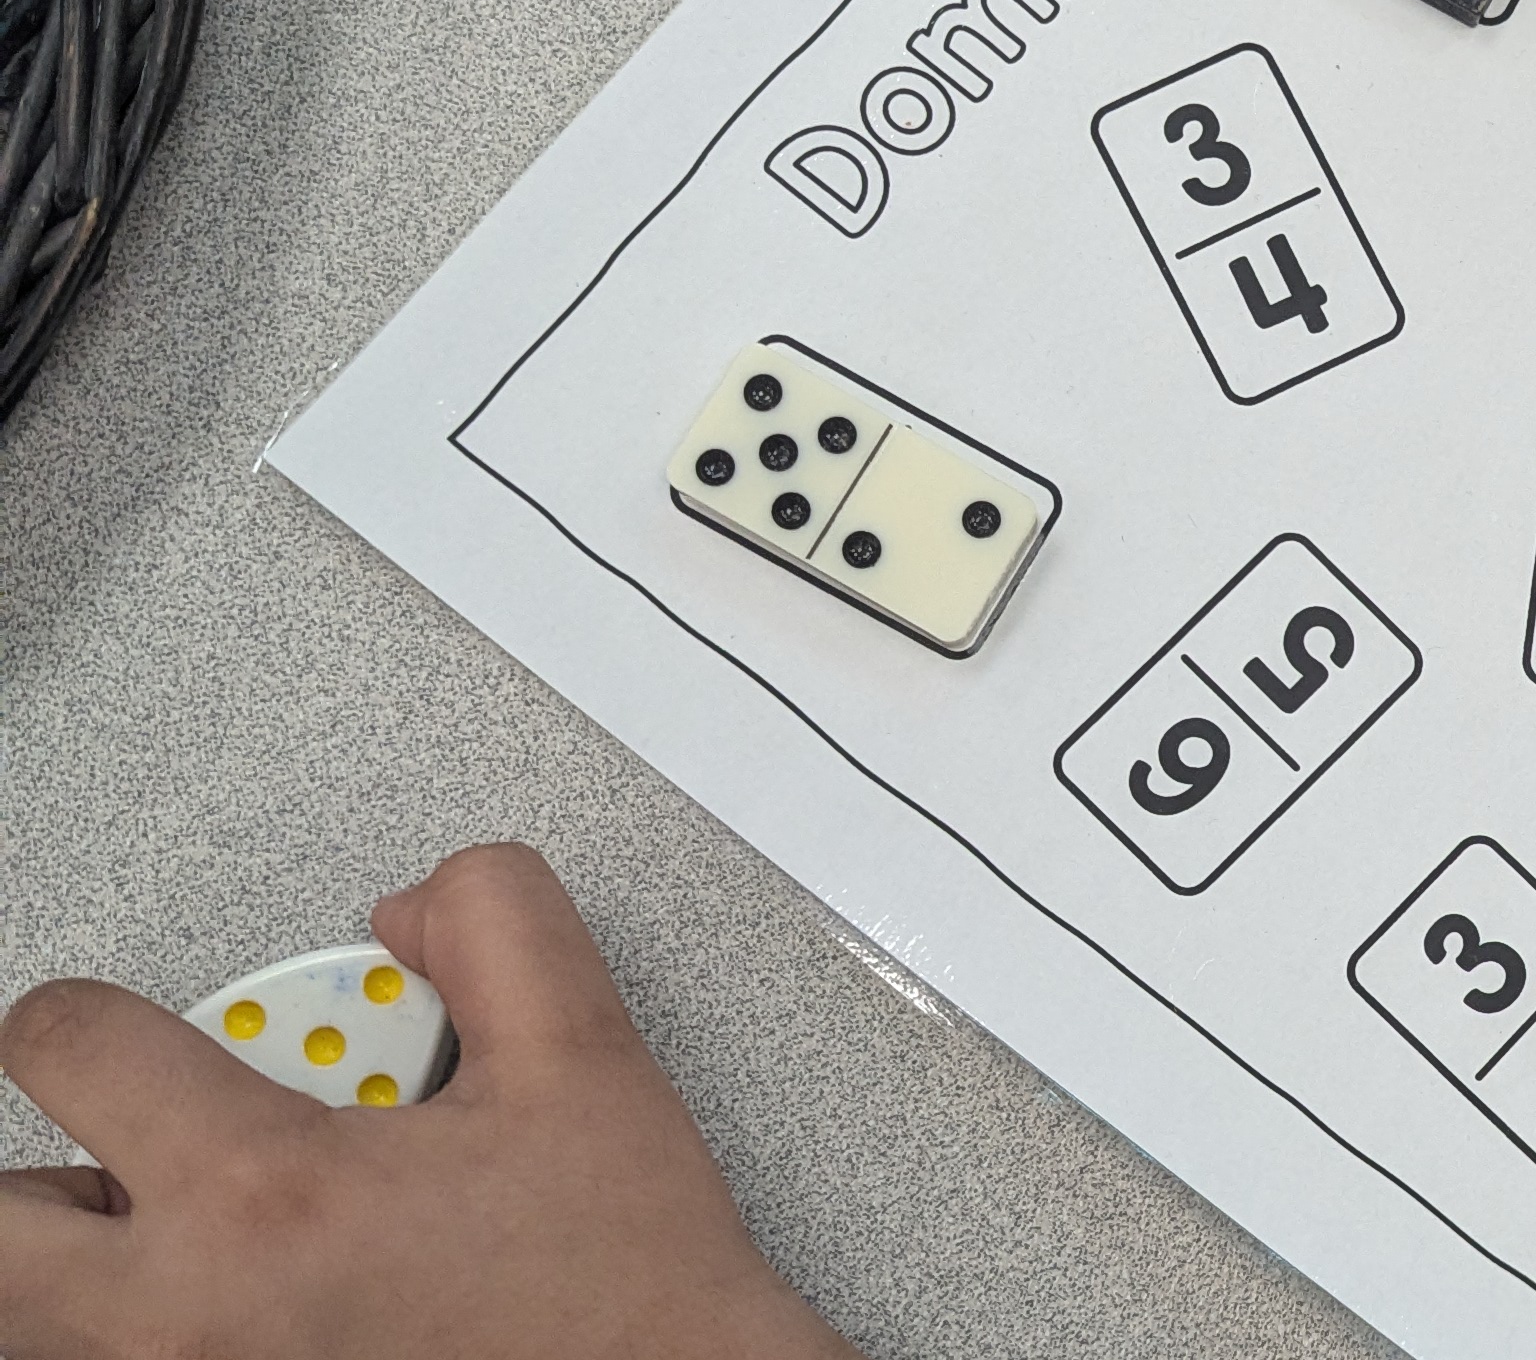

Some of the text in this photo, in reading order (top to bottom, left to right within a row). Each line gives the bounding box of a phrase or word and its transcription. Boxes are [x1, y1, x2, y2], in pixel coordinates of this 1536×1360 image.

[1163, 103, 1252, 207] 3
[1228, 233, 1330, 334] 4
[1242, 605, 1355, 714] 5
[1128, 717, 1231, 816] 6
[1423, 913, 1527, 1014] 3
